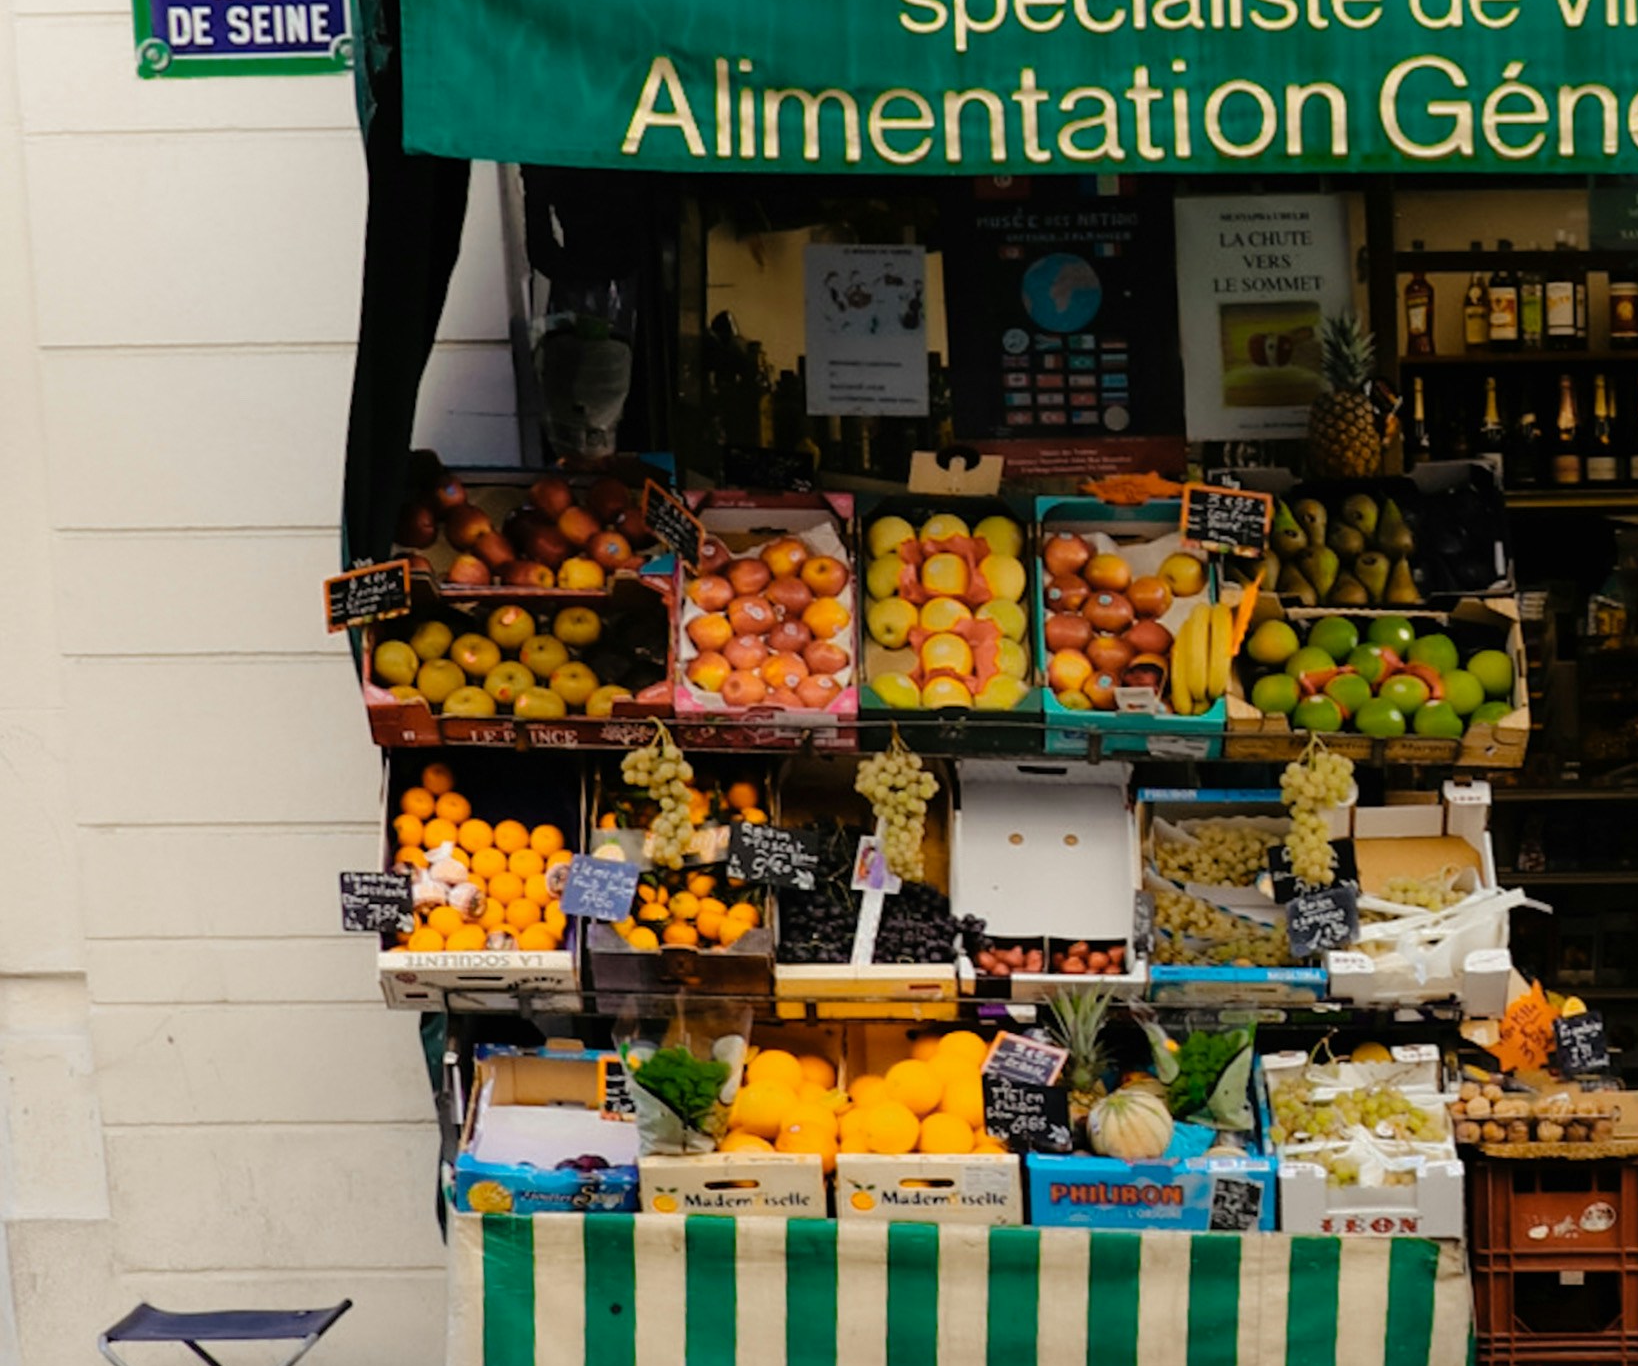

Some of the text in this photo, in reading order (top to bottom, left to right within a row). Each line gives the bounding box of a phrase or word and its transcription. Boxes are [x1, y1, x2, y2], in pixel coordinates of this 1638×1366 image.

[167, 3, 332, 46] DE SEINE
[619, 56, 1348, 164] Alimentation
[1219, 230, 1313, 248] LA CHUTE
[1242, 253, 1292, 270] VERS
[1213, 274, 1324, 293] LE SOMMET
[503, 729, 579, 747] PINCE
